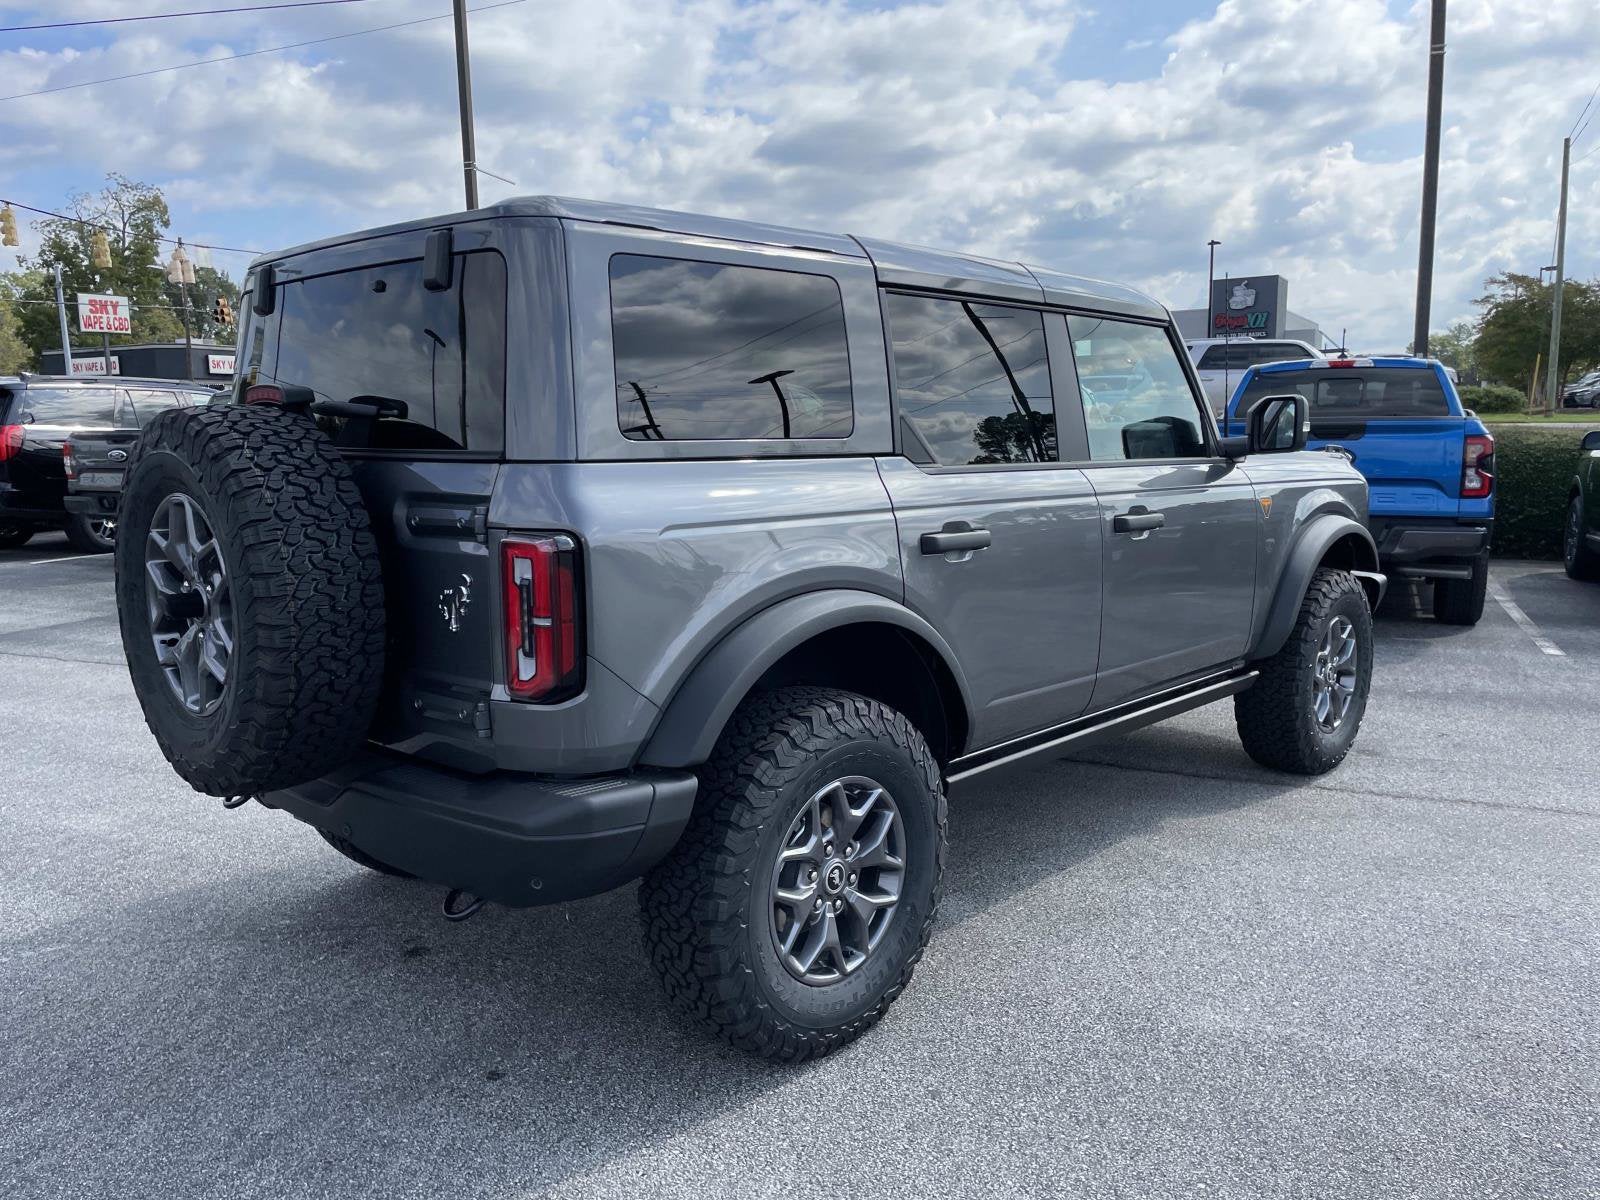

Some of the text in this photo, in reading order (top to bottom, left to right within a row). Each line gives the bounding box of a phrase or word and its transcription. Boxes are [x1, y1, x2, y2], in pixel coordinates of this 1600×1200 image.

[88, 299, 119, 315] SKY
[82, 315, 104, 330] VAPE
[72, 362, 82, 373] SKY
[84, 361, 99, 371] VAPE
[211, 360, 225, 369] SKY
